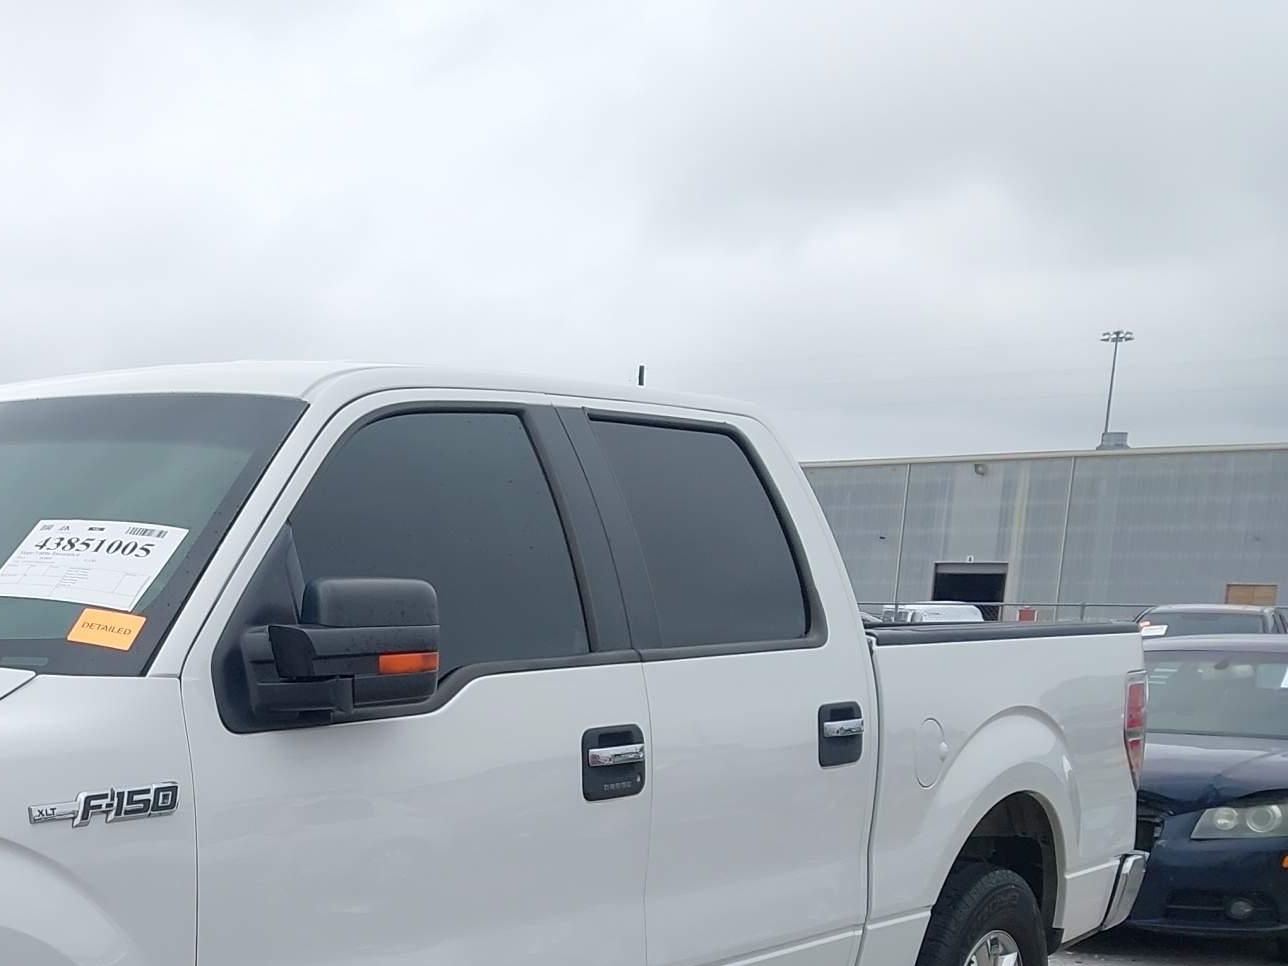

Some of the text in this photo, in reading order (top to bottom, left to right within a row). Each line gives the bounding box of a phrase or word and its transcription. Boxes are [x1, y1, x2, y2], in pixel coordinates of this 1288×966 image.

[34, 536, 156, 558] 43851005
[81, 620, 132, 636] DETAILED
[37, 783, 179, 824] XLT F-150
